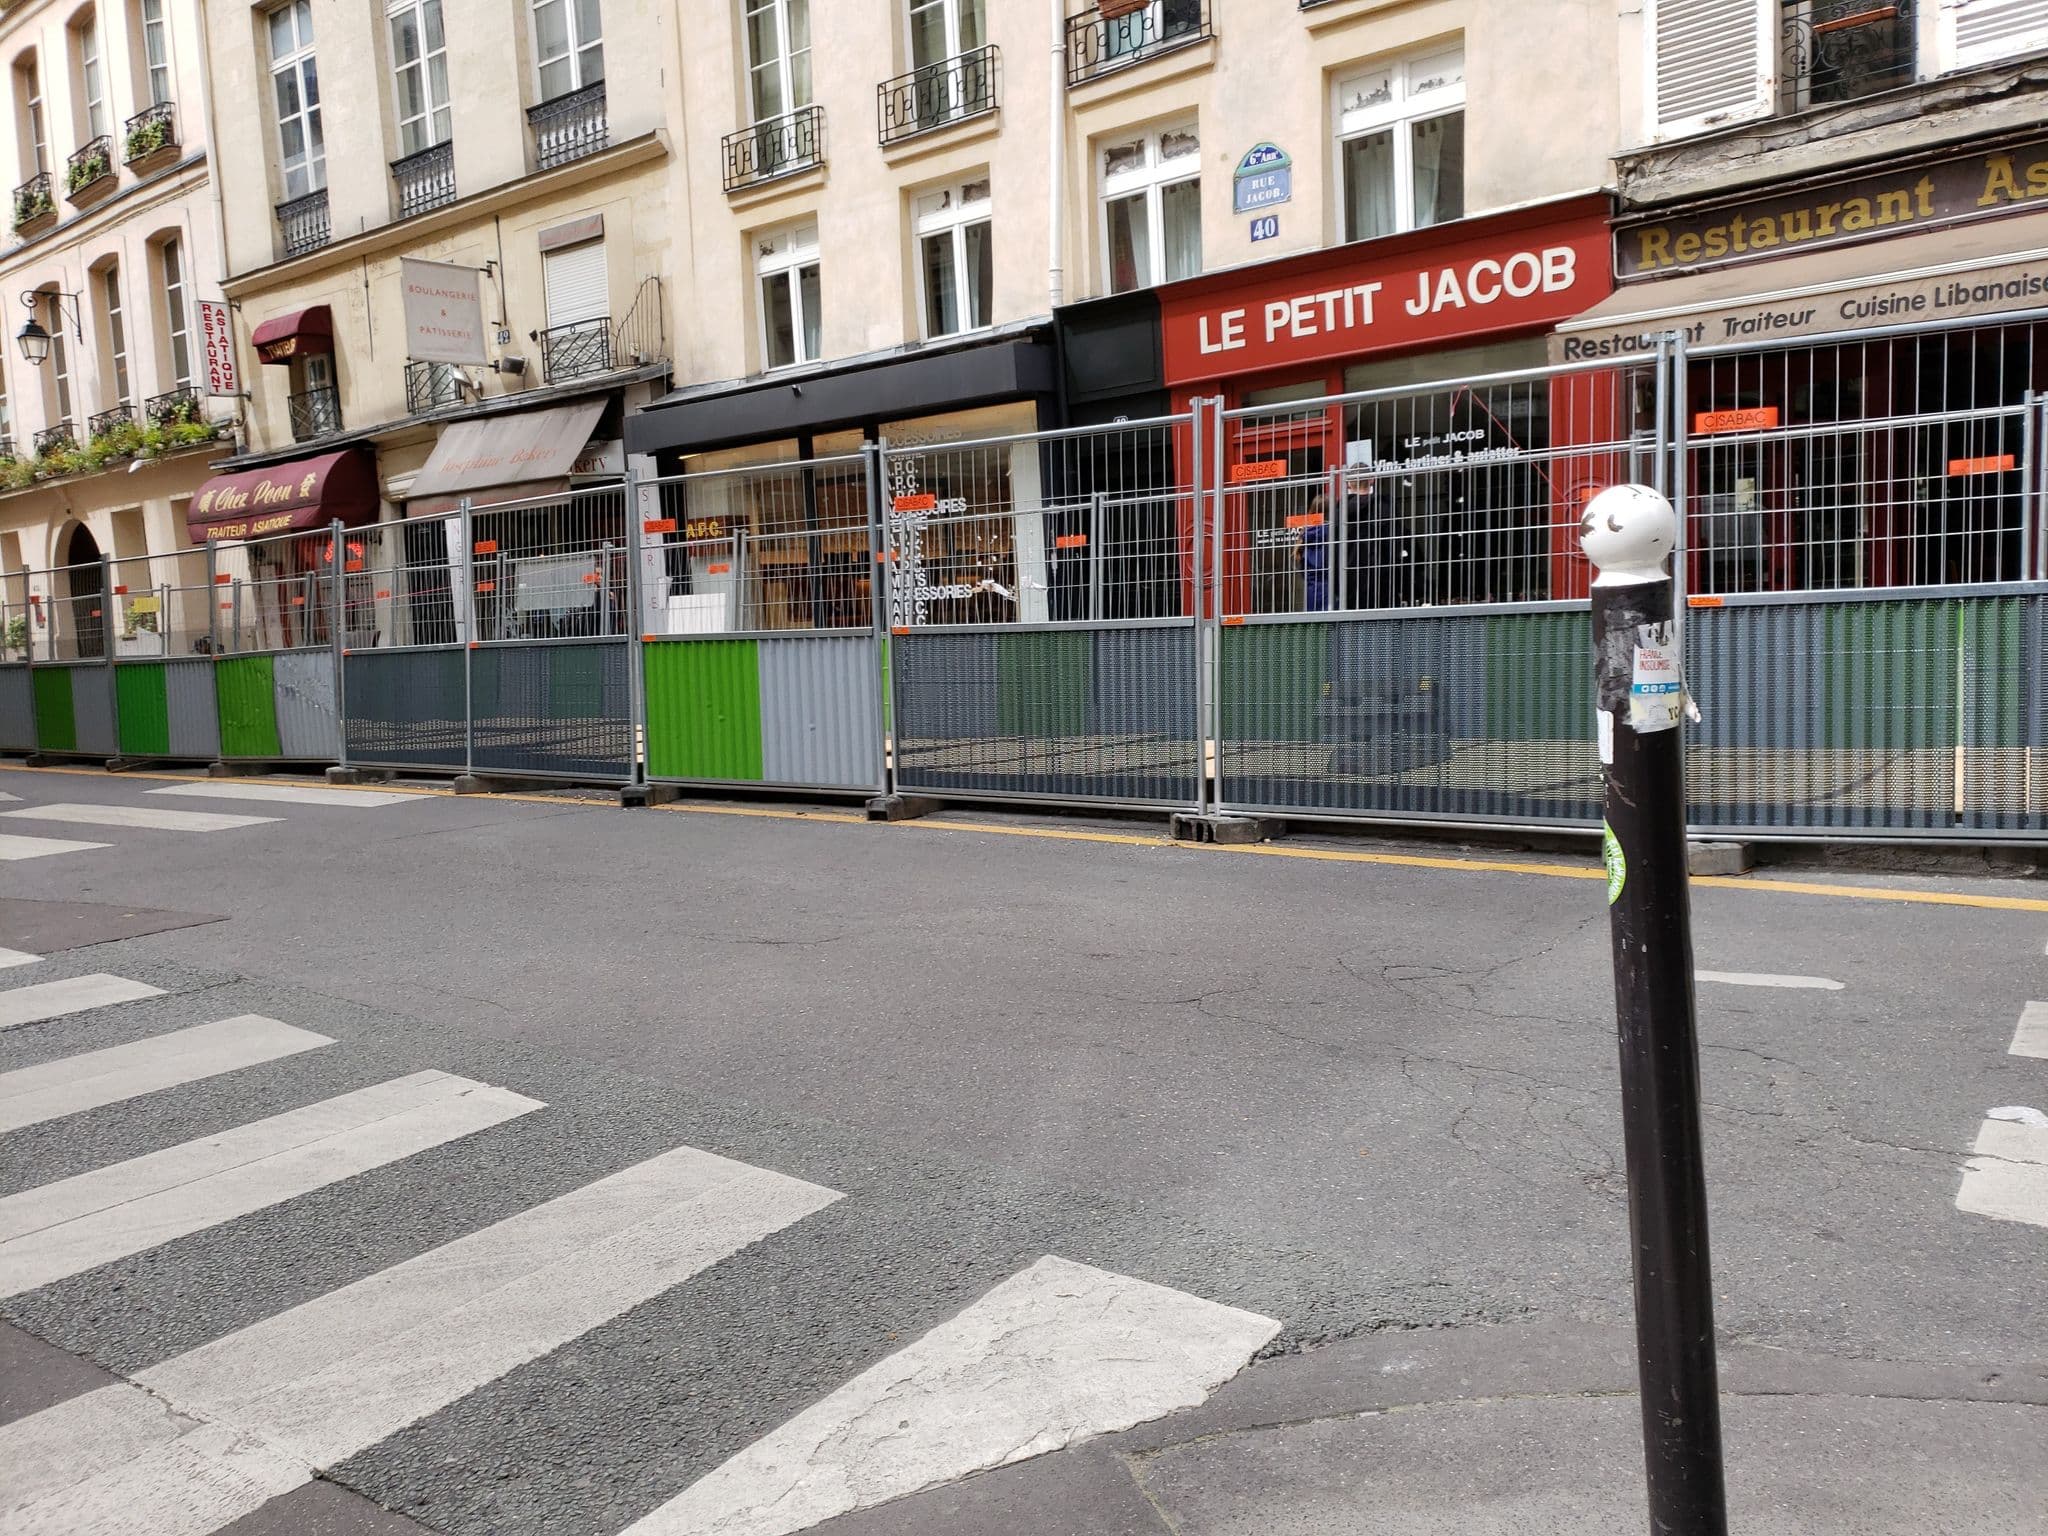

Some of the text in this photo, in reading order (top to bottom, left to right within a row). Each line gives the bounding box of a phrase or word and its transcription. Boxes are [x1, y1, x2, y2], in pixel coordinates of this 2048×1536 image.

[1252, 175, 1275, 189] RUE
[1253, 218, 1276, 240] 40
[1637, 175, 1936, 271] Restaurant
[408, 284, 478, 302] BOULANGERIE
[1199, 246, 1577, 354] LE PETIT JACOB
[441, 308, 447, 316] &
[1564, 322, 1705, 361] Restaunt
[1722, 307, 1816, 337] Traiteur
[1840, 291, 1926, 320] Cuisine
[202, 304, 221, 393] RESTAURANT
[215, 308, 233, 390] ASIATIQUE
[1703, 411, 1766, 428] CISABAC
[1404, 436, 1421, 448] LE
[1442, 429, 1485, 444] JACOB
[214, 486, 249, 512] Chez
[253, 480, 292, 505] Poon
[207, 514, 293, 539] TRAITEUR ASIATIQUE
[892, 585, 972, 602] AESSORIES
